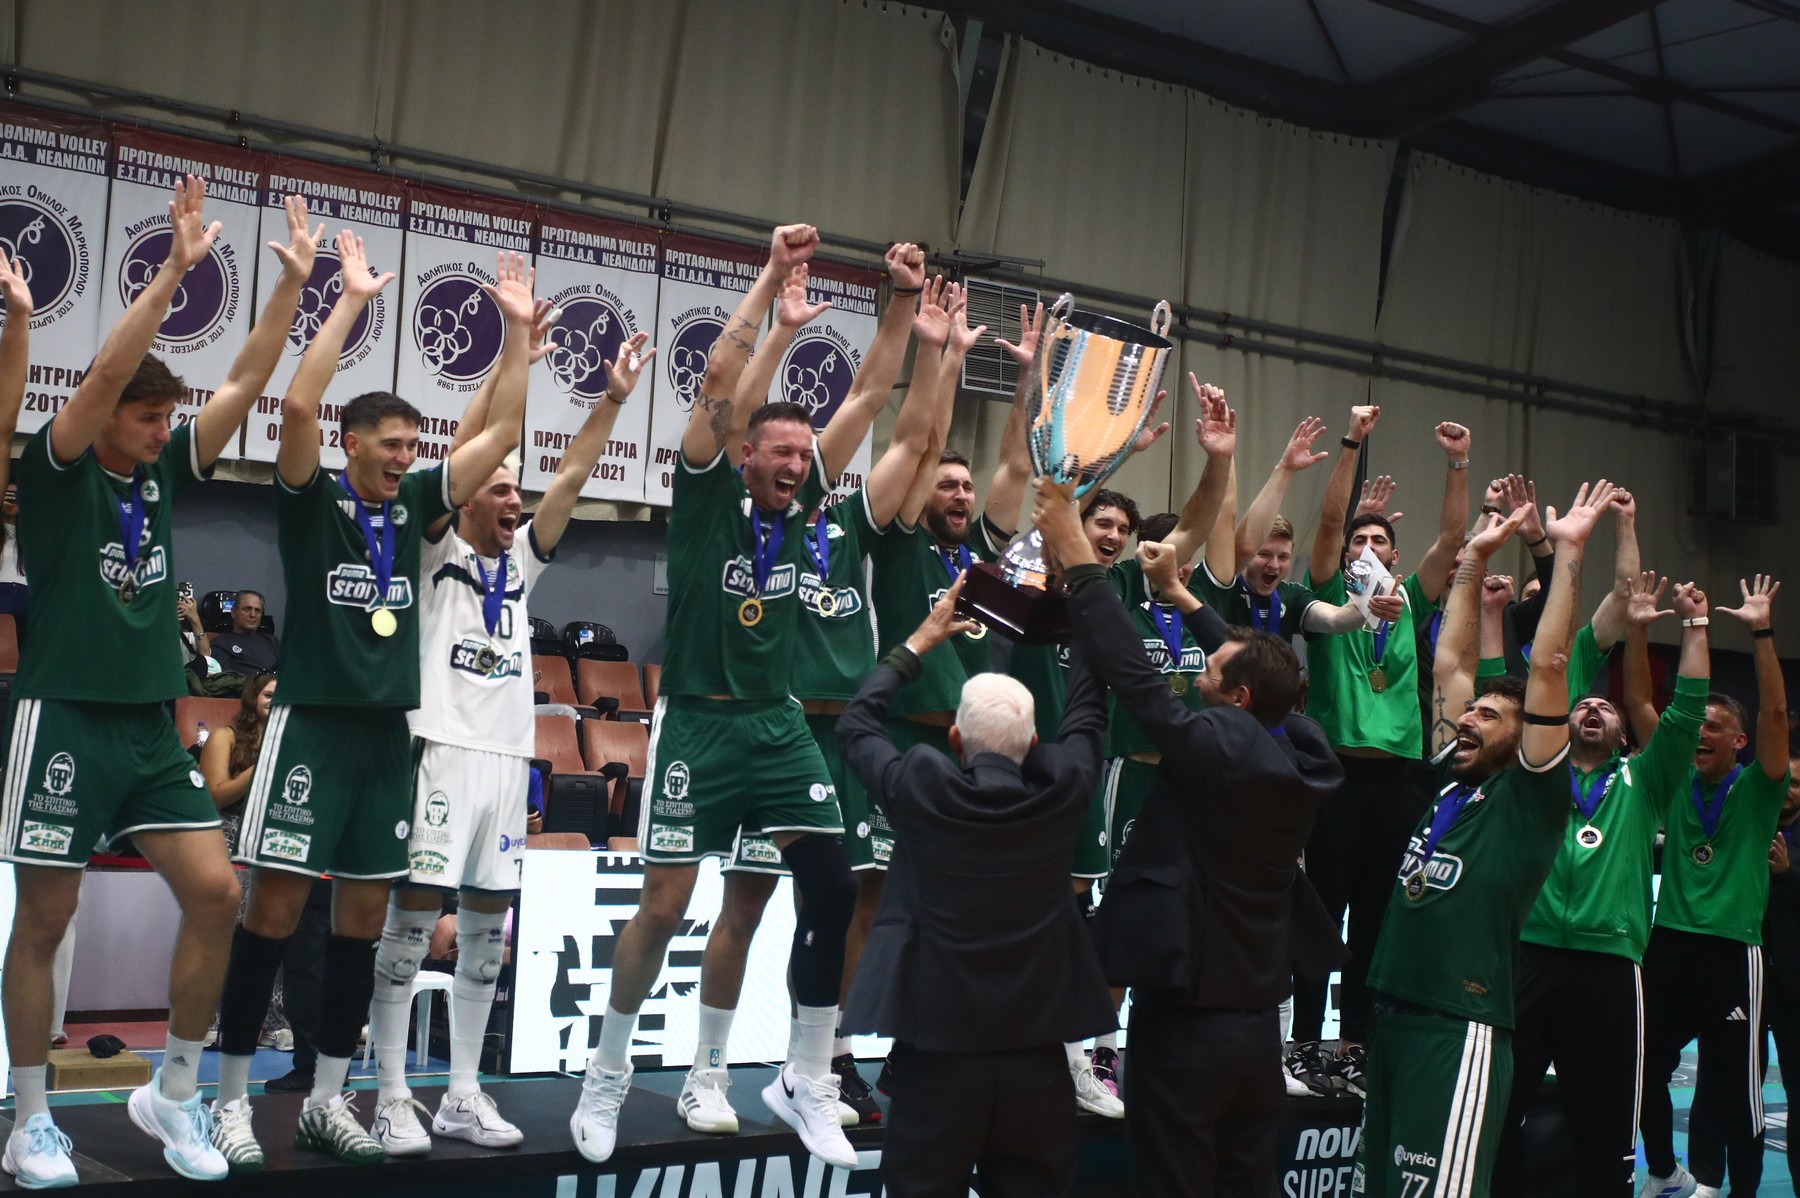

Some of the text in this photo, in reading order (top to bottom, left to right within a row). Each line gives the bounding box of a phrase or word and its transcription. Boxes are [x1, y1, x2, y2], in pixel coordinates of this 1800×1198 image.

[0, 123, 108, 156] ΘΛΗΜΑ VOLLEY
[36, 148, 106, 175] ΝΕΑΝΙΔΩΝ
[118, 145, 260, 188] ΠΡΩΤΑΘΛΗΜΑ VOLLEY
[203, 180, 258, 206] ΕΑΝΙΔΩΝ
[269, 174, 401, 211] ΠΡΩΤΑΘΛΗΜΑ VOLLEY
[339, 204, 400, 227] ΝΕΑΝΙΔΩΝ
[410, 200, 532, 236] ΠΡΩΤΑΘΛΗΜΑ VOLLEY
[474, 229, 531, 252] ΝΕΑΝΙΔΩΝ
[541, 225, 656, 257] ΠΡΩΤΑΘΛΗΜΑ VOLLEY
[601, 252, 656, 273] ΝΕΑΝΙΔΩΝ
[665, 248, 734, 274] ΠΡΩΤΑΘΛΗΜΑ
[416, 262, 463, 287] ΑΘΛΗΤΙΚΟΣ
[595, 283, 625, 311] ΟΜΙΛΟΣ
[806, 275, 844, 295] ΑΘΛΗΜΑ
[846, 282, 877, 301] VOLLEY
[831, 295, 876, 315] ΝΕΑΝΙΔΩΝ
[591, 462, 625, 482] 2021
[33, 793, 44, 802] ΤΟ
[273, 802, 283, 811] ΤΟ
[656, 799, 665, 807] ΤΟ
[1295, 1126, 1361, 1161] nov
[1401, 1151, 1437, 1168] υγεία
[1283, 1166, 1352, 1198] SUPE
[1401, 1170, 1430, 1198] 77
